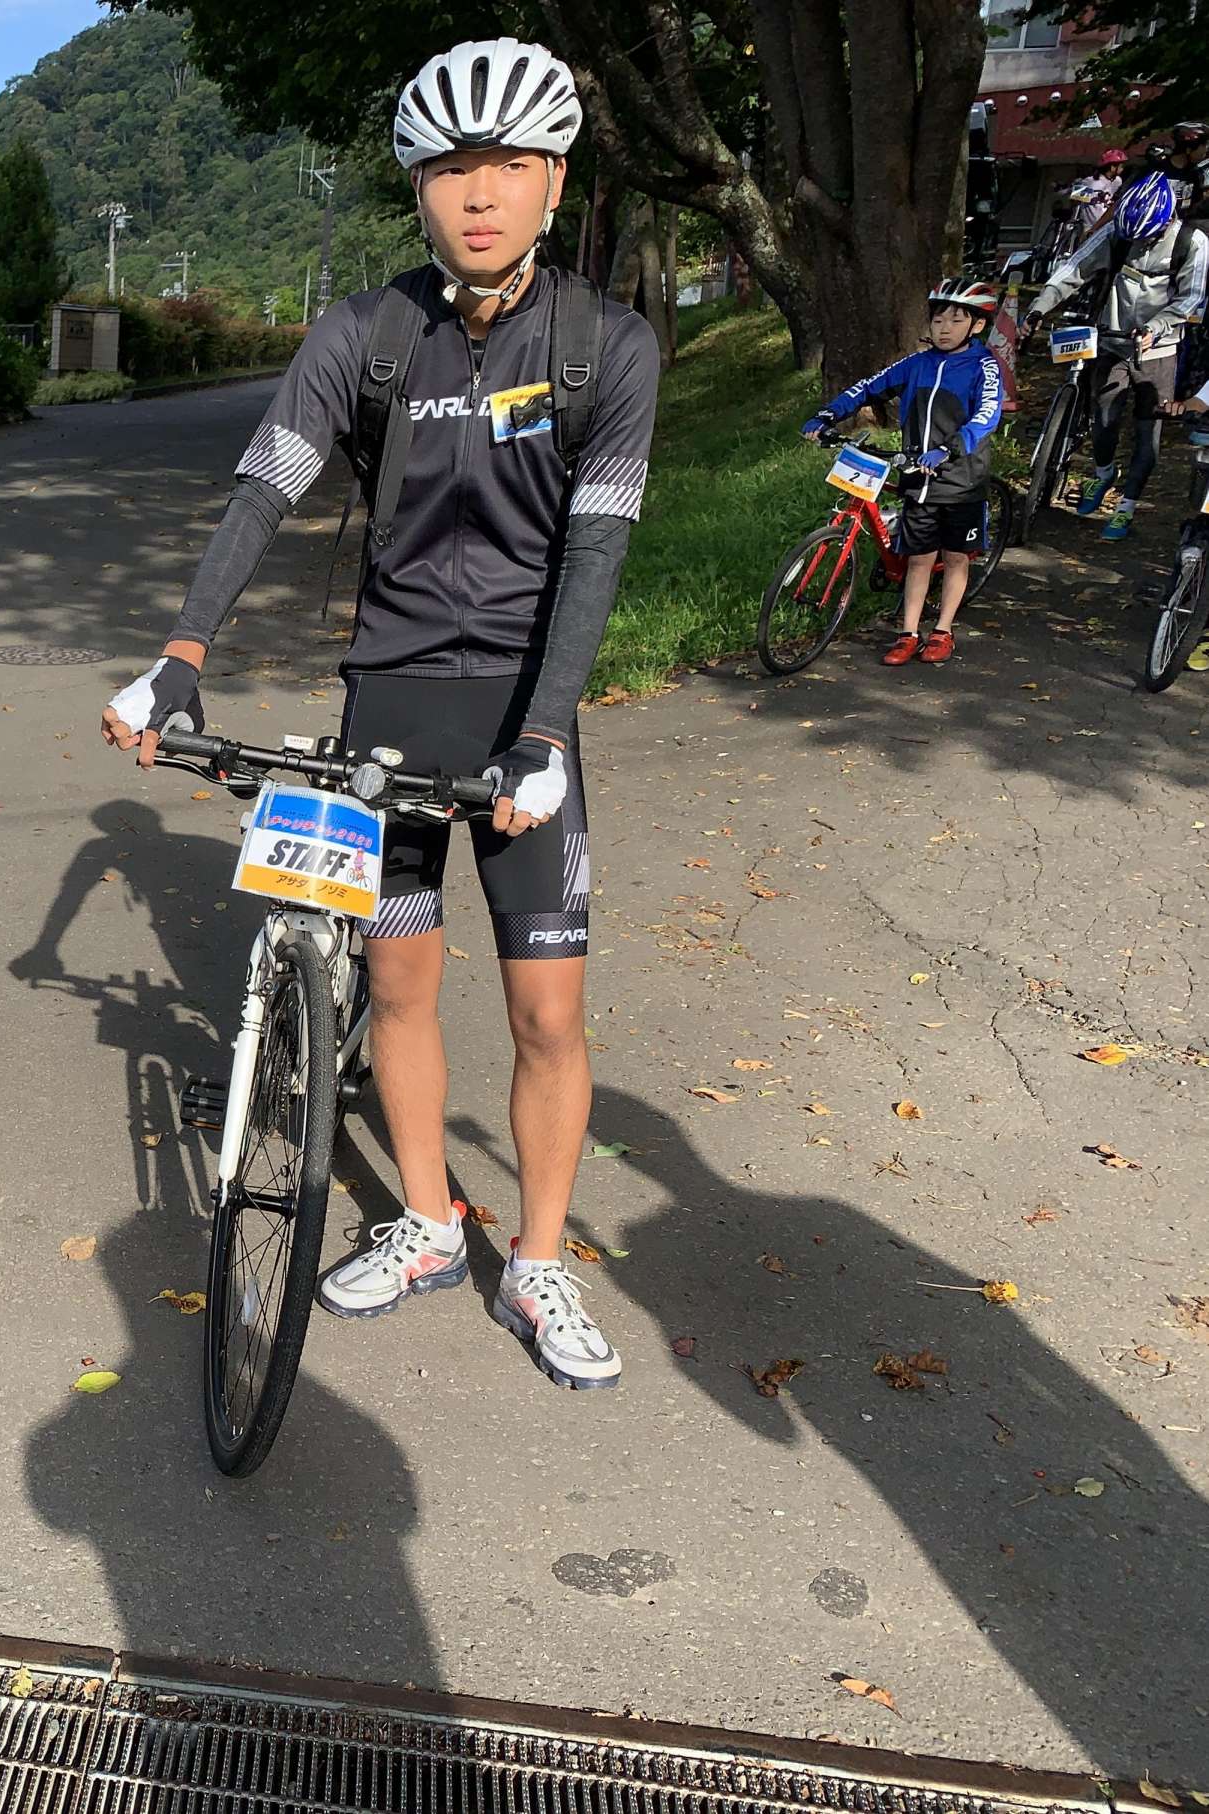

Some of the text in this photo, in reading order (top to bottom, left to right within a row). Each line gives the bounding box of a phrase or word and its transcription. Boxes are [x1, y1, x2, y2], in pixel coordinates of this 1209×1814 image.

[1060, 342, 1081, 353] STAFF
[409, 395, 473, 421] EARL
[849, 472, 861, 483] 2
[266, 839, 351, 878] STAFF
